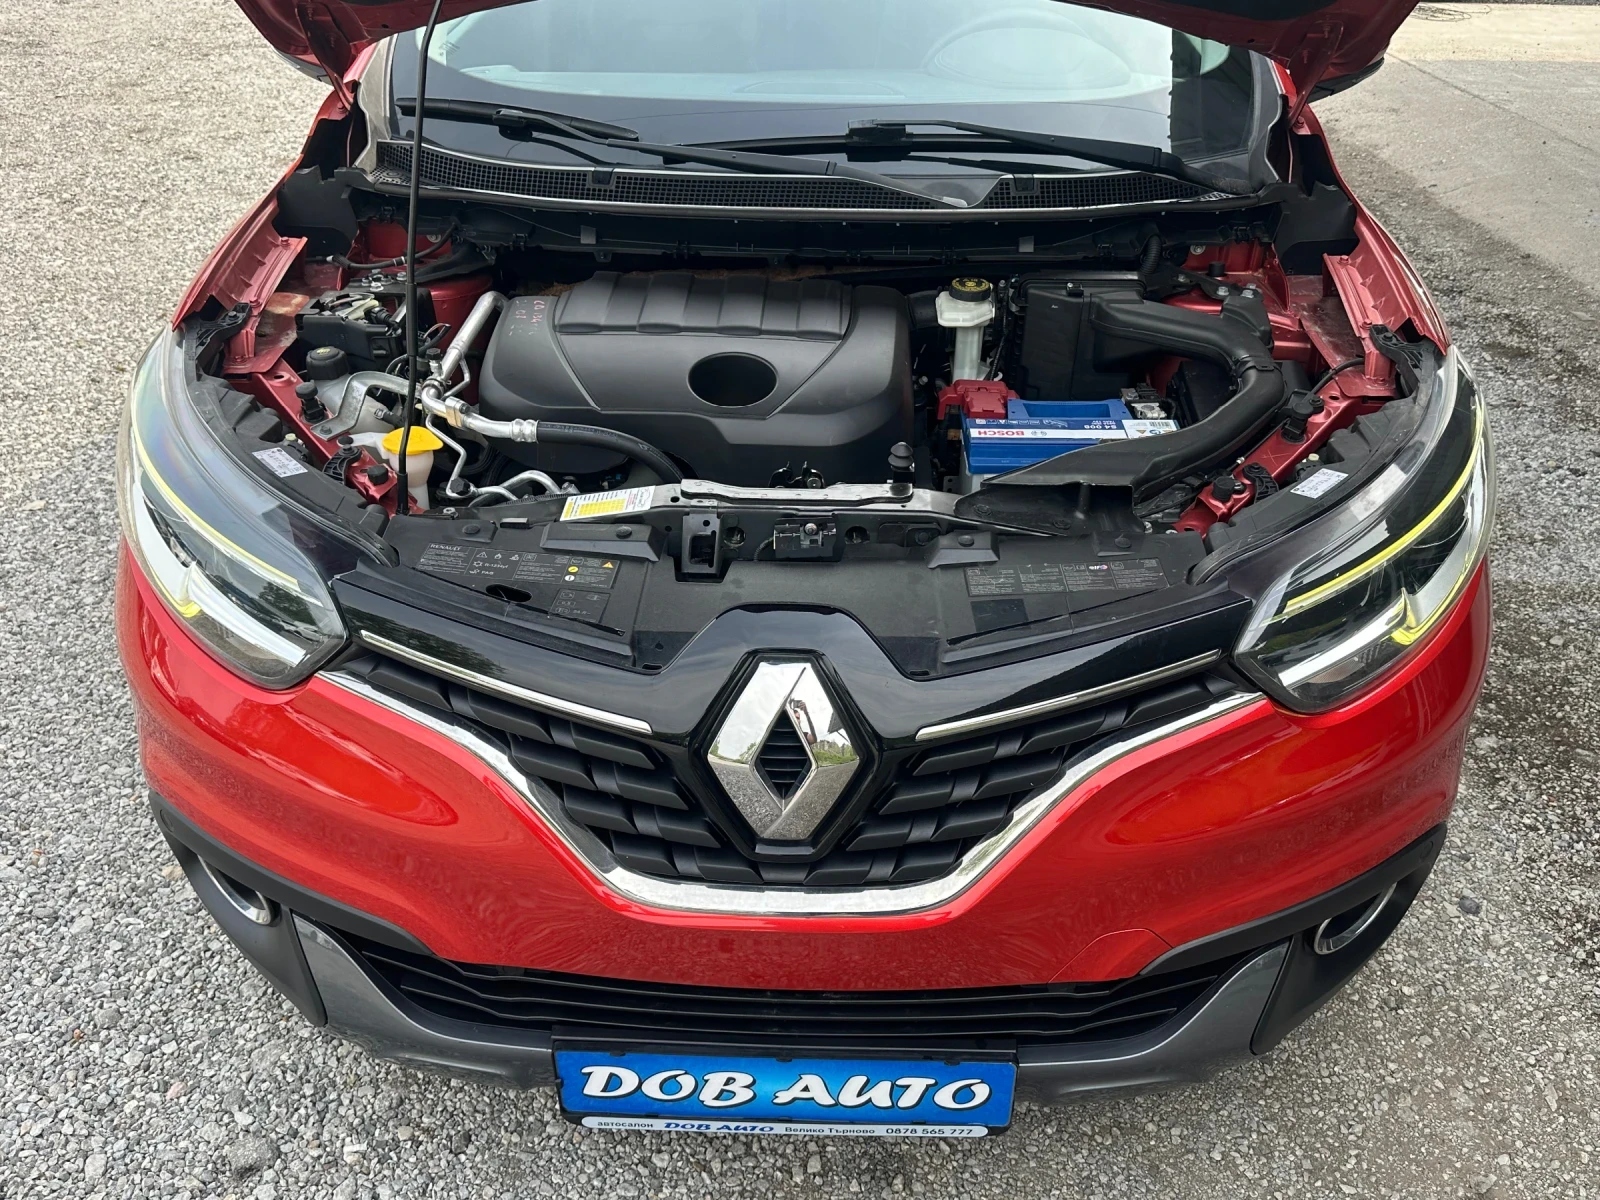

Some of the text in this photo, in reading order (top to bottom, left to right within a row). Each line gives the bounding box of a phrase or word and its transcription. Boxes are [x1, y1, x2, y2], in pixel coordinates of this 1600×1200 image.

[430, 543, 461, 551] RENAULT
[580, 1066, 992, 1111] DOB AUTO
[597, 1120, 654, 1129] автосалон
[663, 1122, 775, 1133] DOB AUTO
[785, 1126, 876, 1135] Велико Търново
